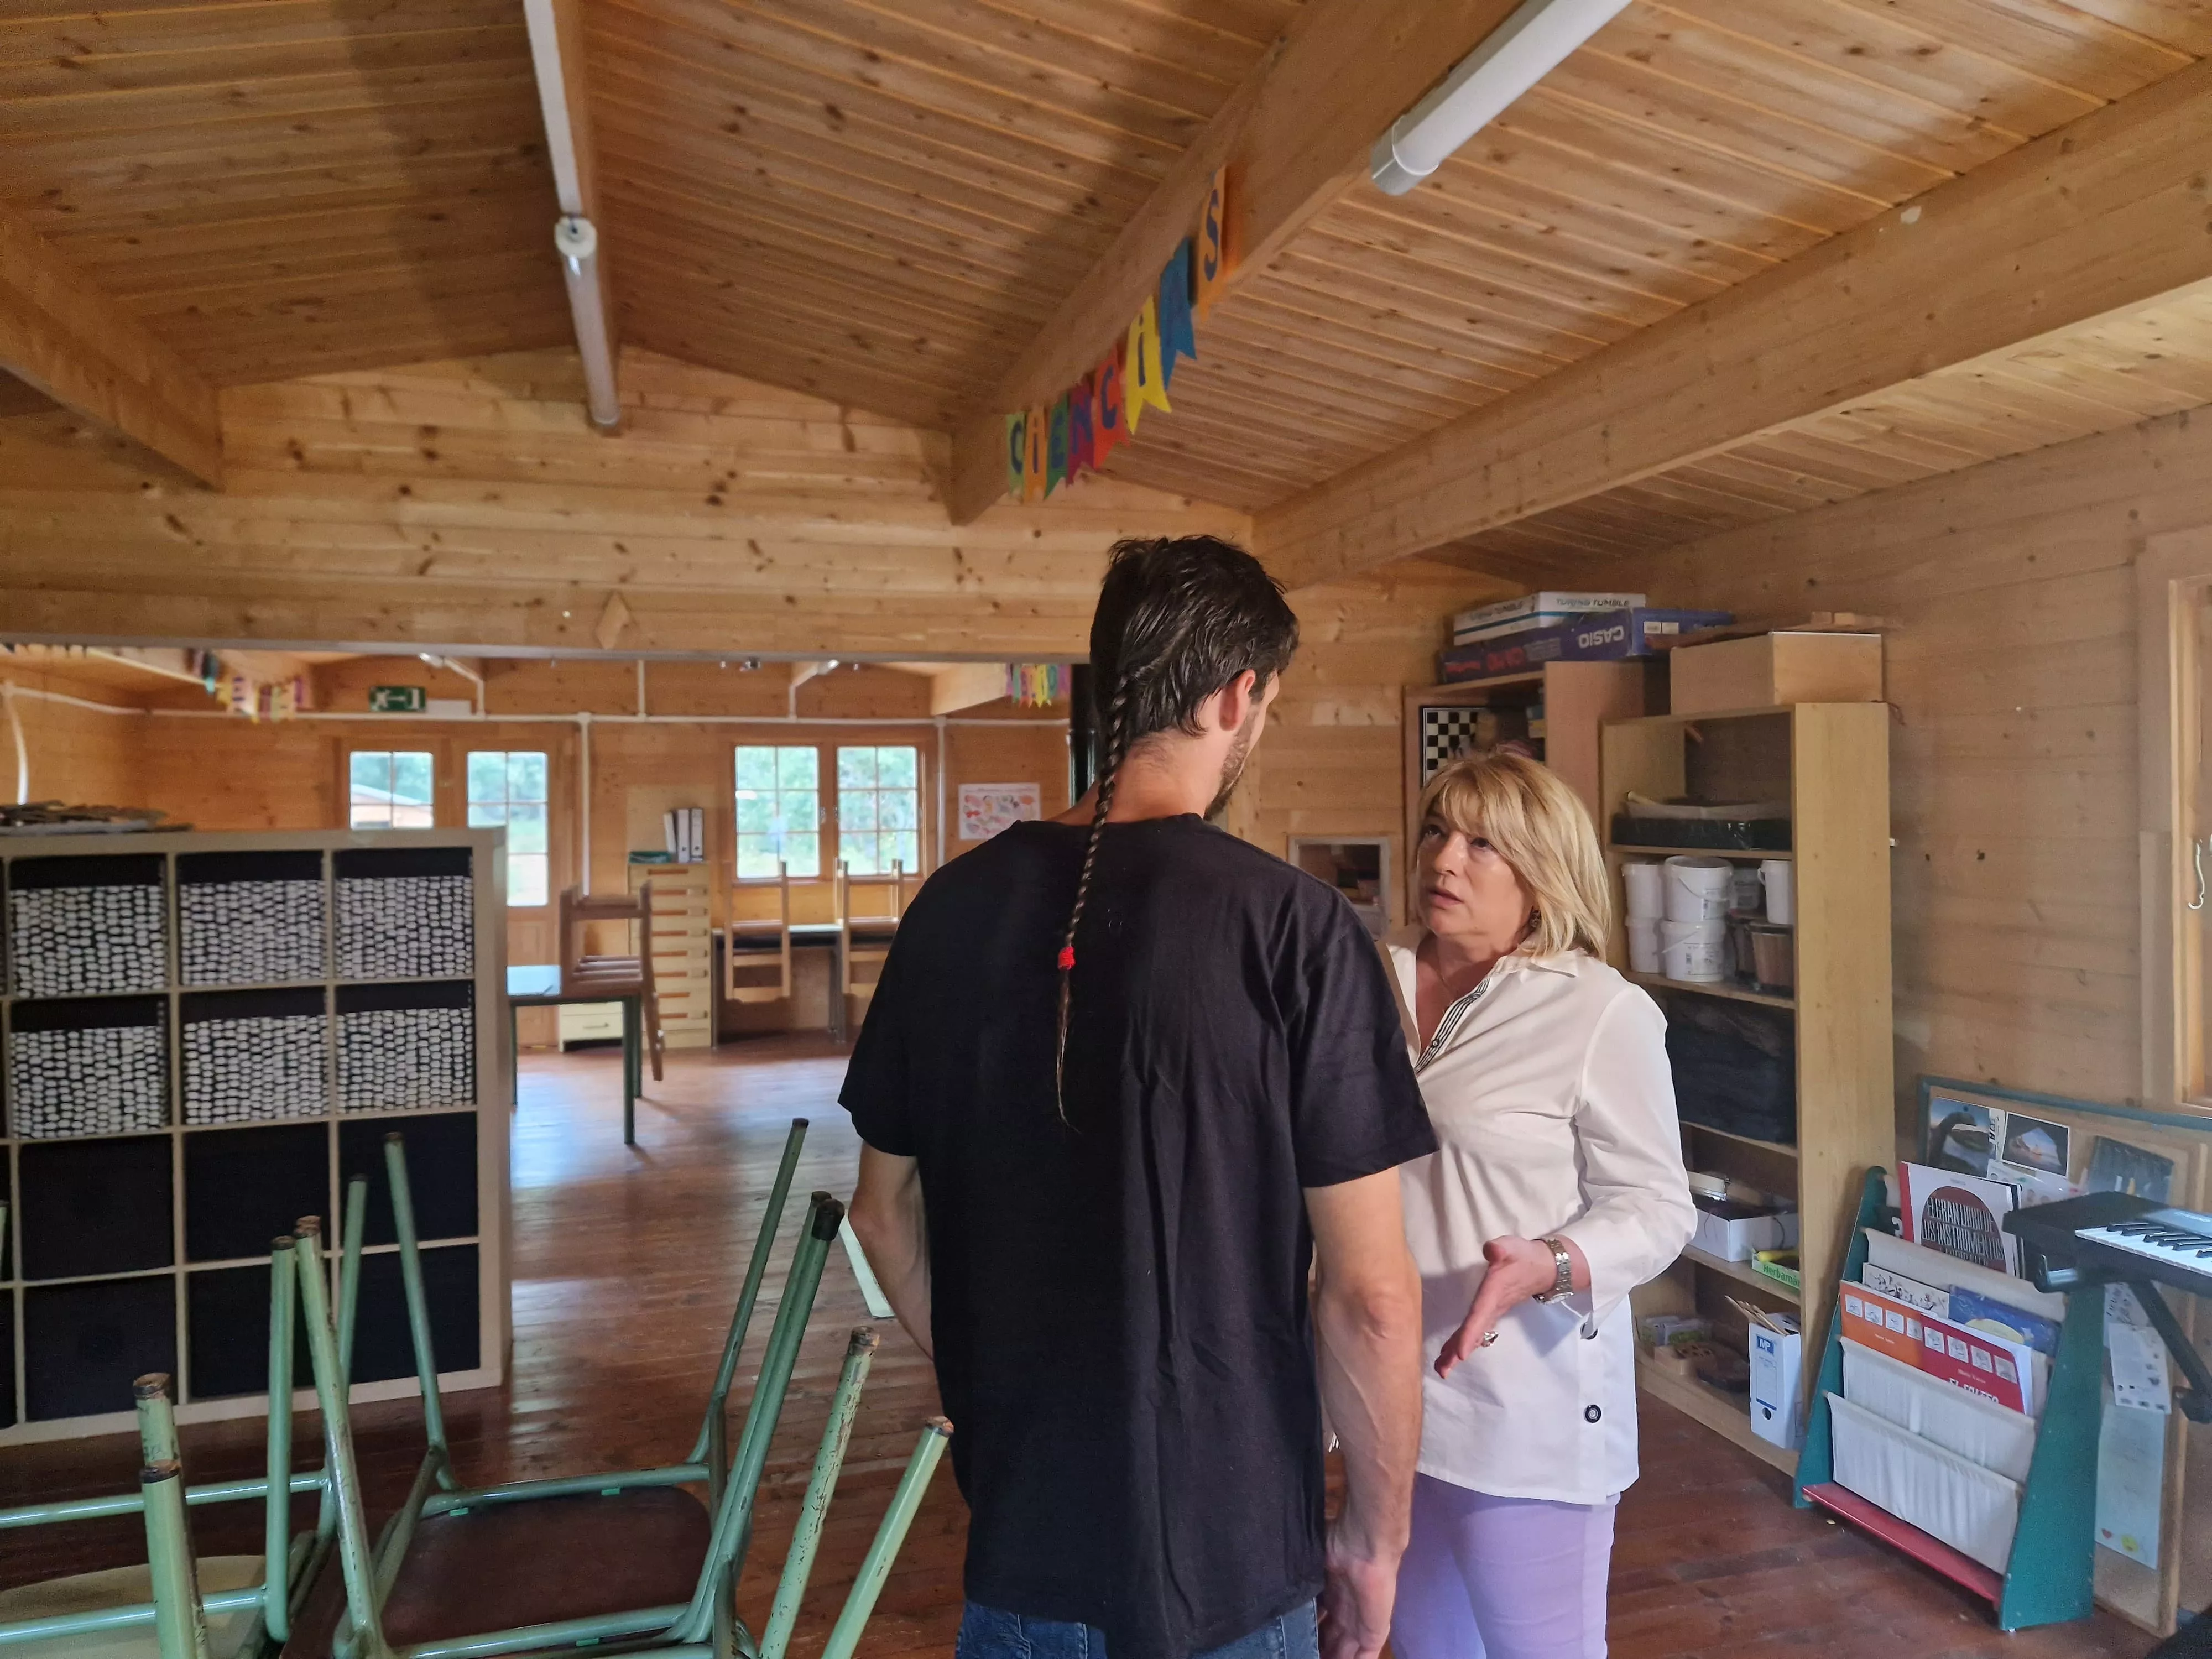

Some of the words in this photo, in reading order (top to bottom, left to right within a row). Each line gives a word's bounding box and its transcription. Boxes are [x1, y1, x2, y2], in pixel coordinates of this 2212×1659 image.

[1579, 625, 1625, 649] CASIO
[1936, 1199, 1960, 1225] GRAN
[1937, 1222, 2005, 1261] INSTRUMENTOS
